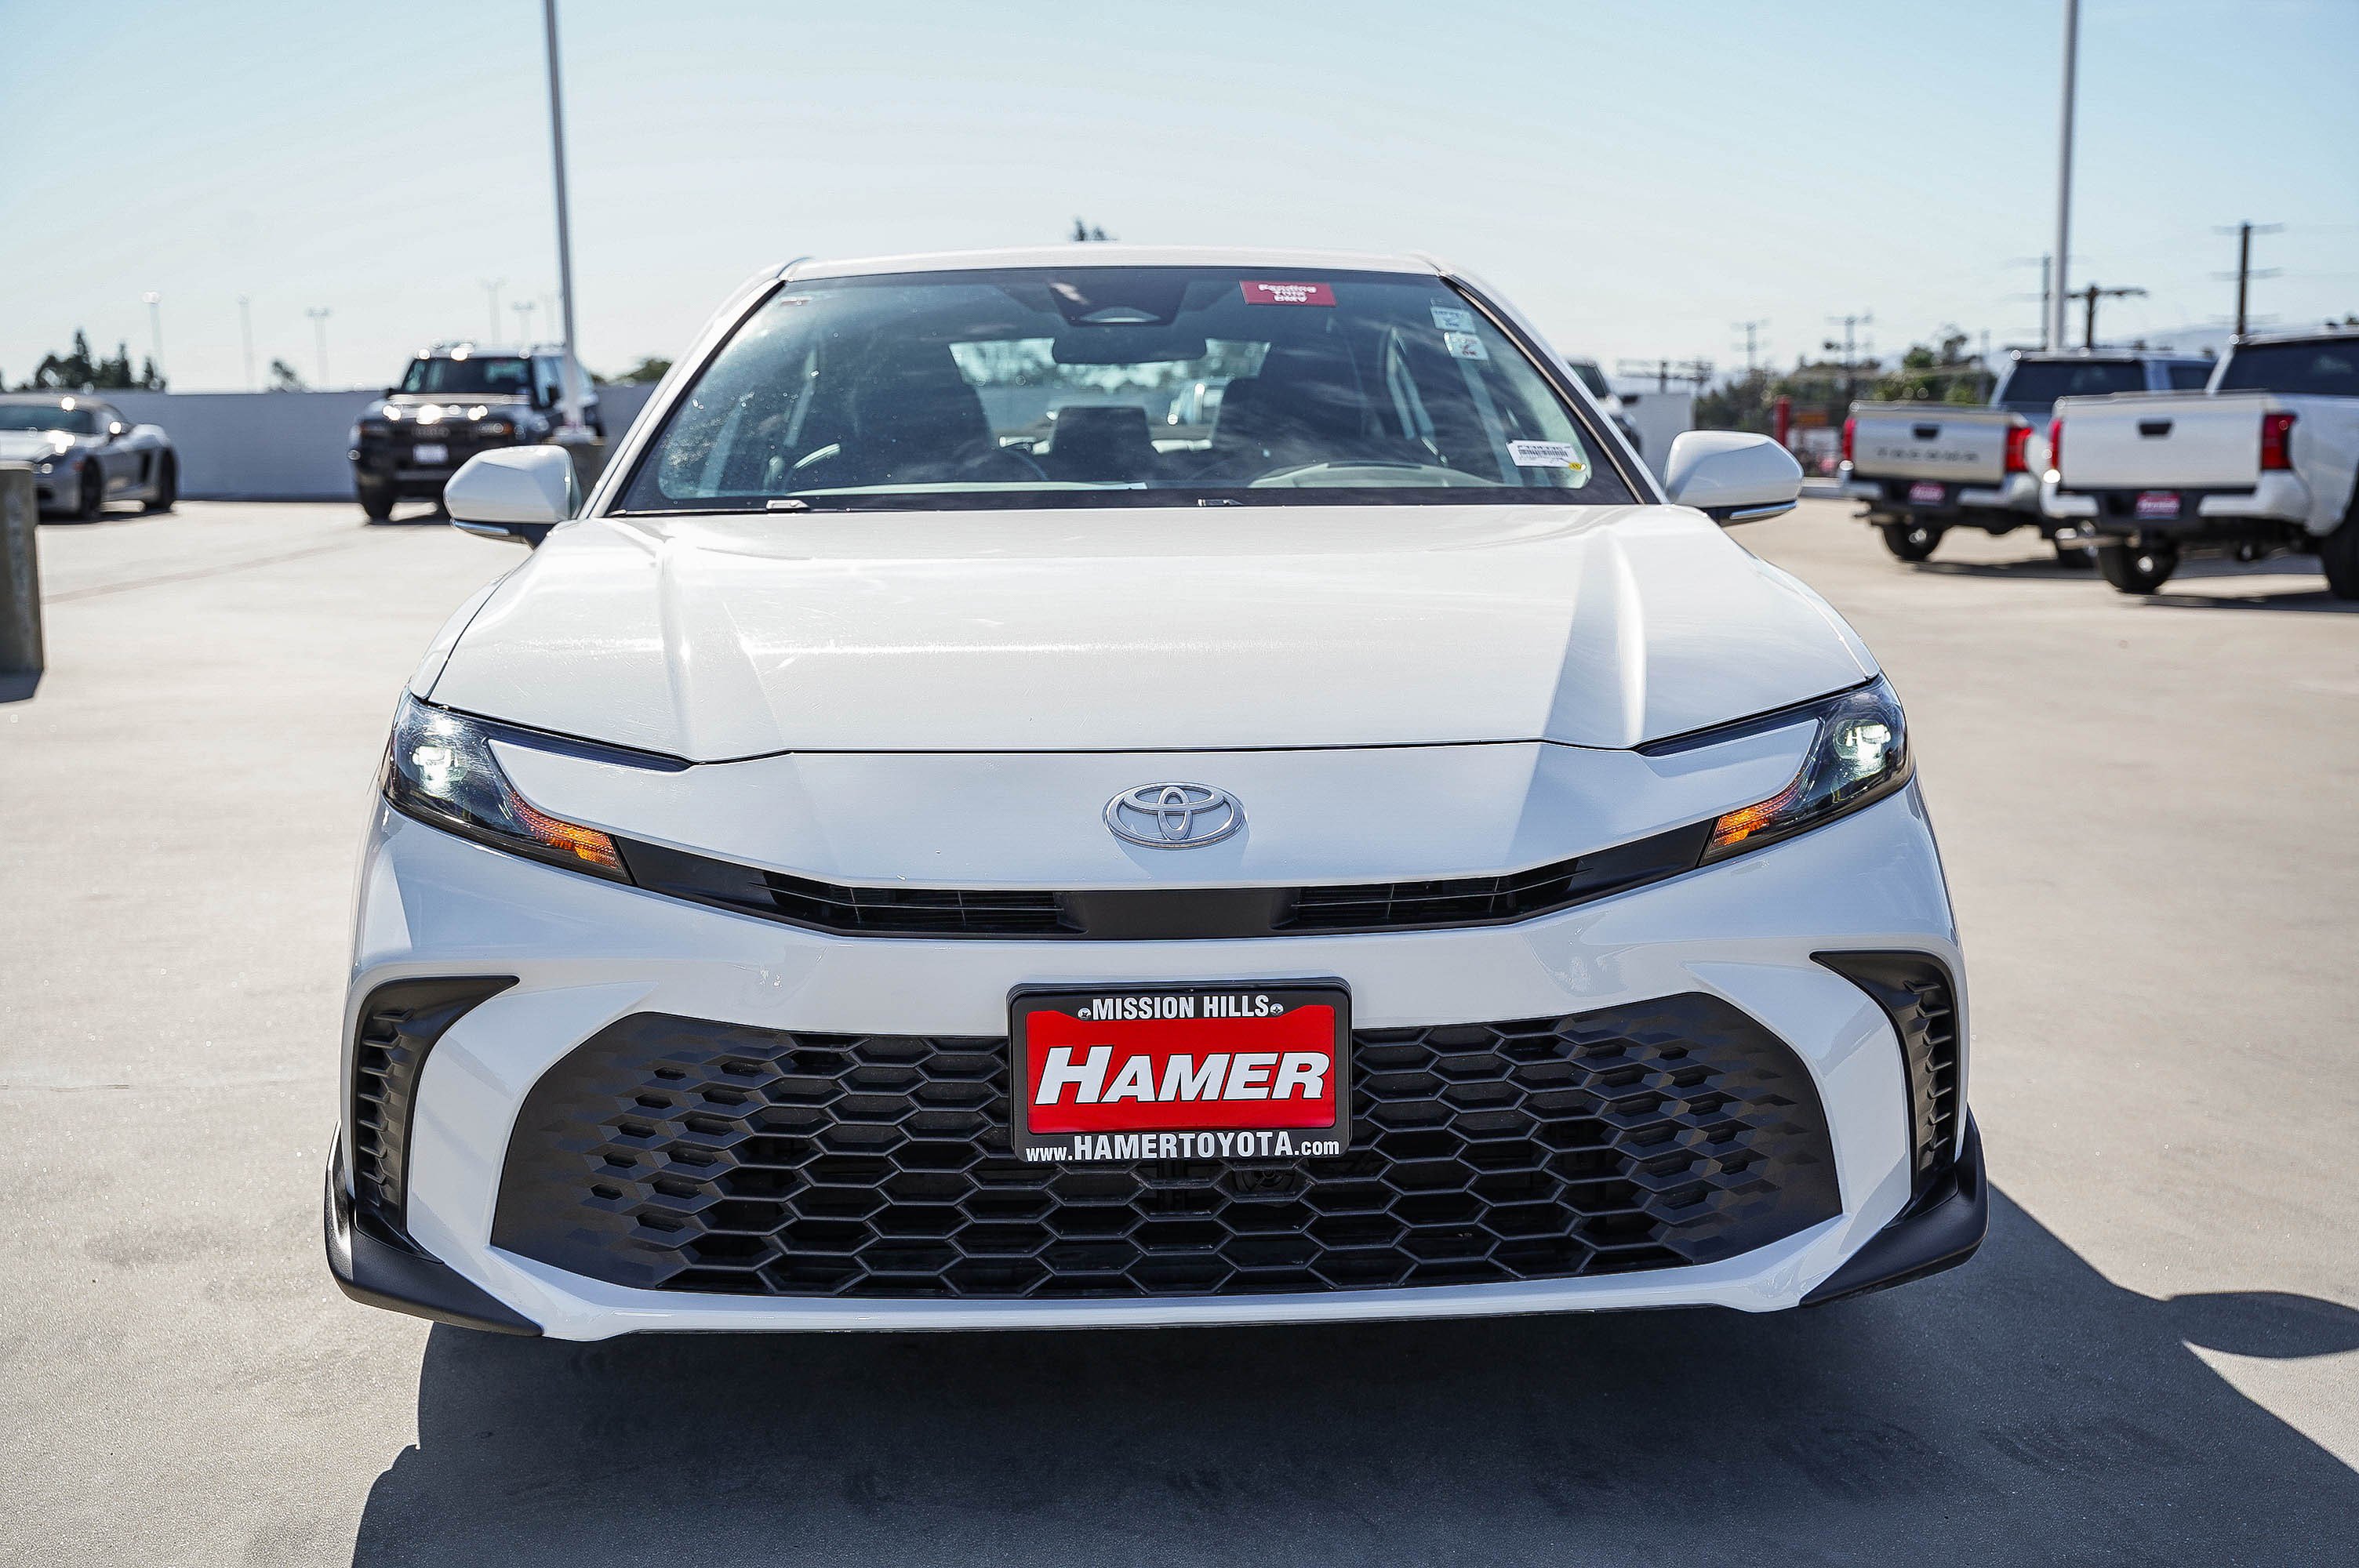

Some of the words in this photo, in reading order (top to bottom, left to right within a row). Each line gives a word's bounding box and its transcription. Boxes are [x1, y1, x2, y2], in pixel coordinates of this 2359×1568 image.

[1092, 996, 1194, 1020] MISSION
[1203, 995, 1270, 1018] HILLS
[1034, 1045, 1331, 1105] HAMER
[1025, 1131, 1340, 1163] www.HAMERTOYOTA.com
